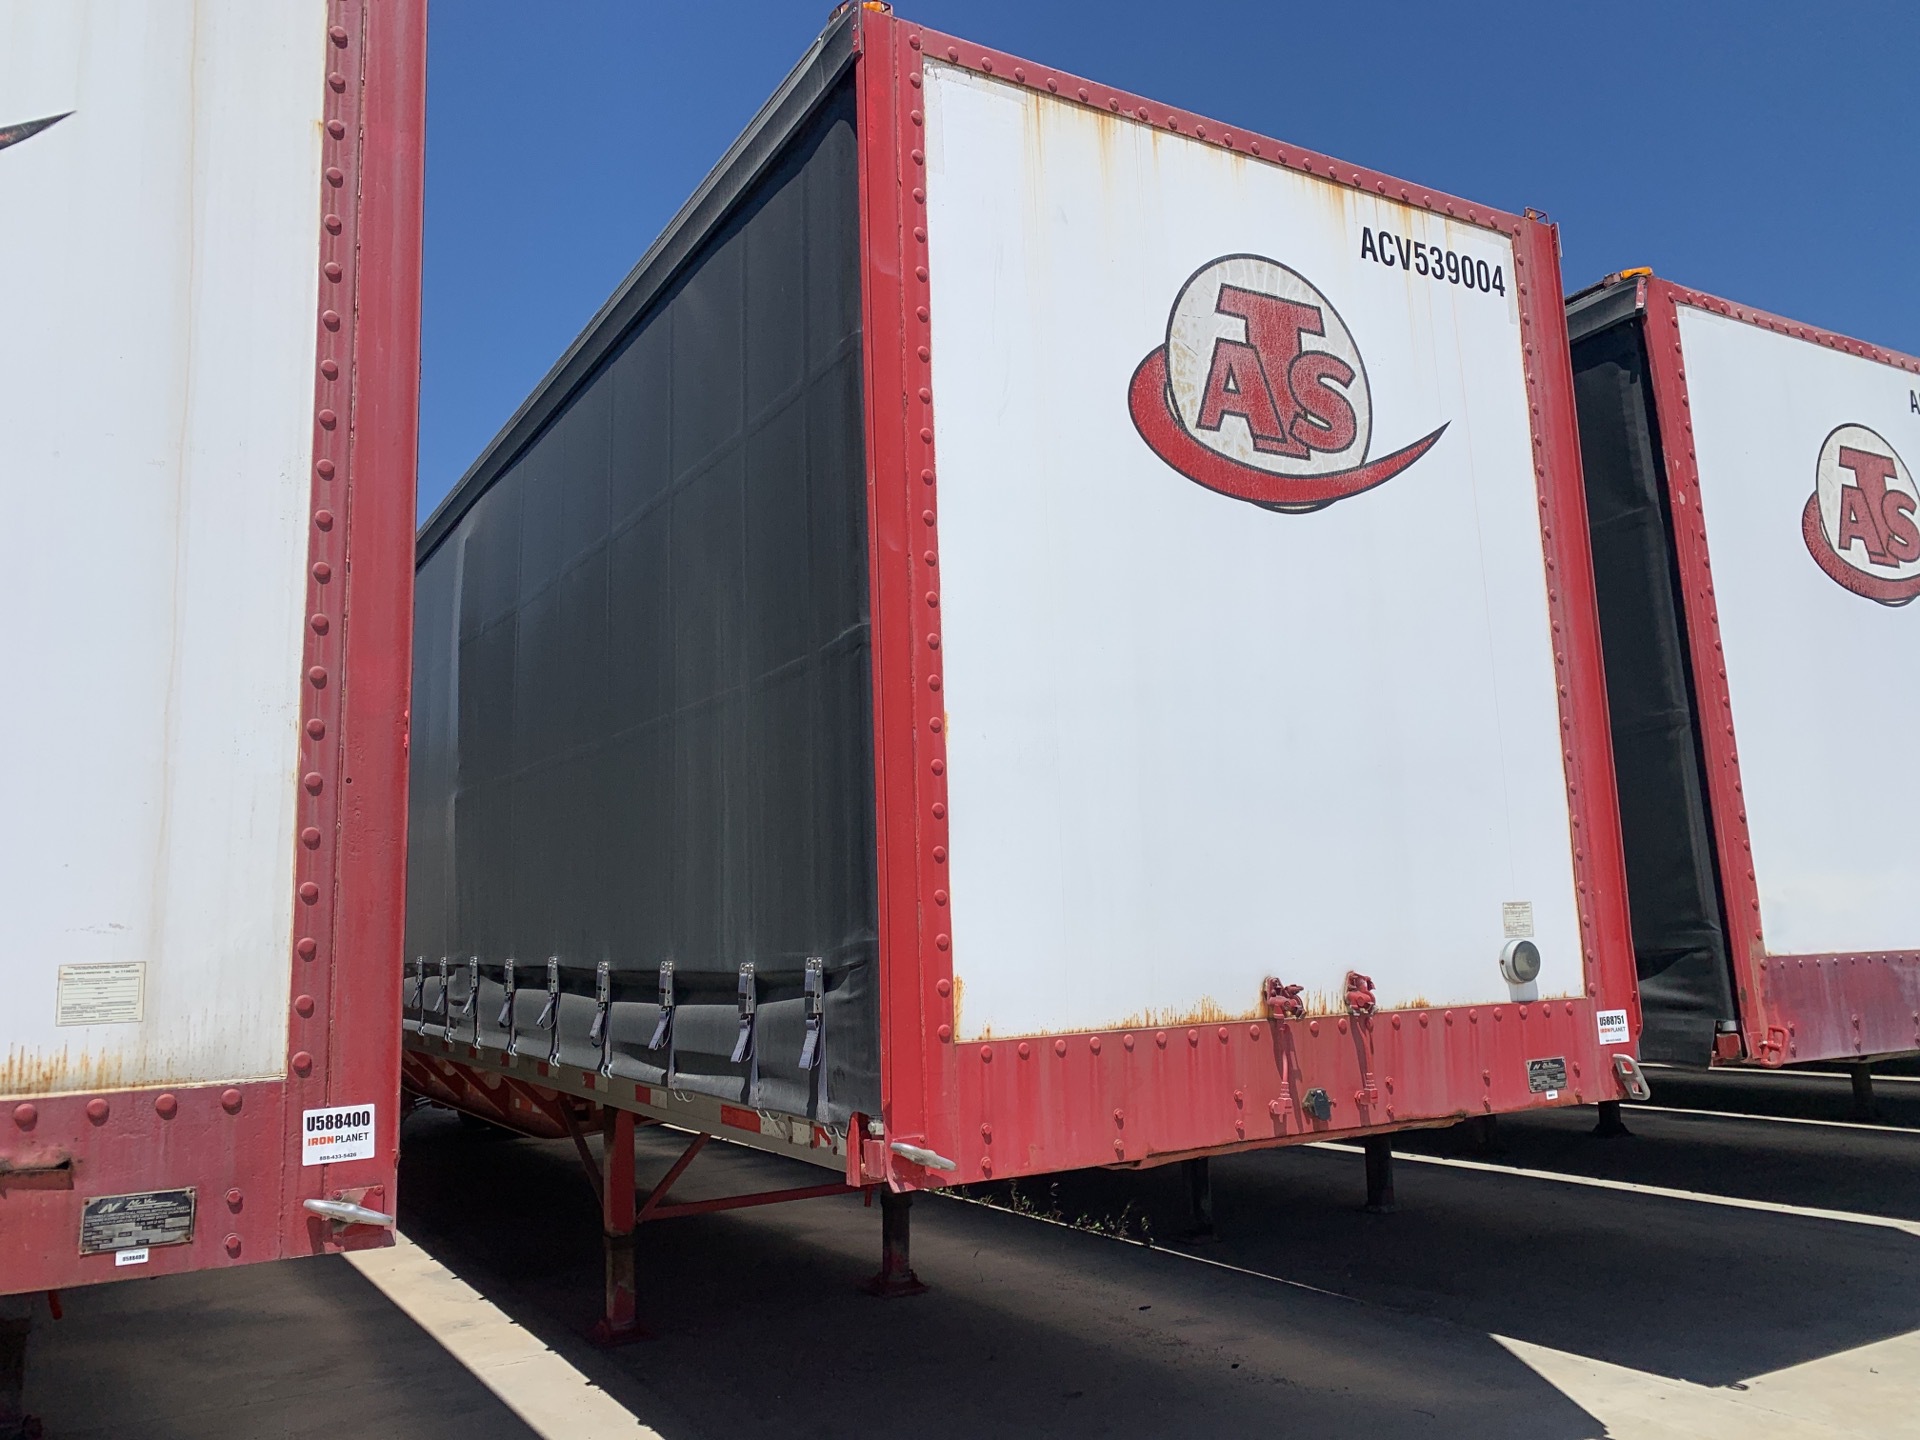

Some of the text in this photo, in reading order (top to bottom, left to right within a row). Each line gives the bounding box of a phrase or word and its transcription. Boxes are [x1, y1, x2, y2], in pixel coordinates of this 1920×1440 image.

[1361, 227, 1505, 297] ACV539004
[1910, 389, 1920, 415] A
[306, 1111, 371, 1132] U588400
